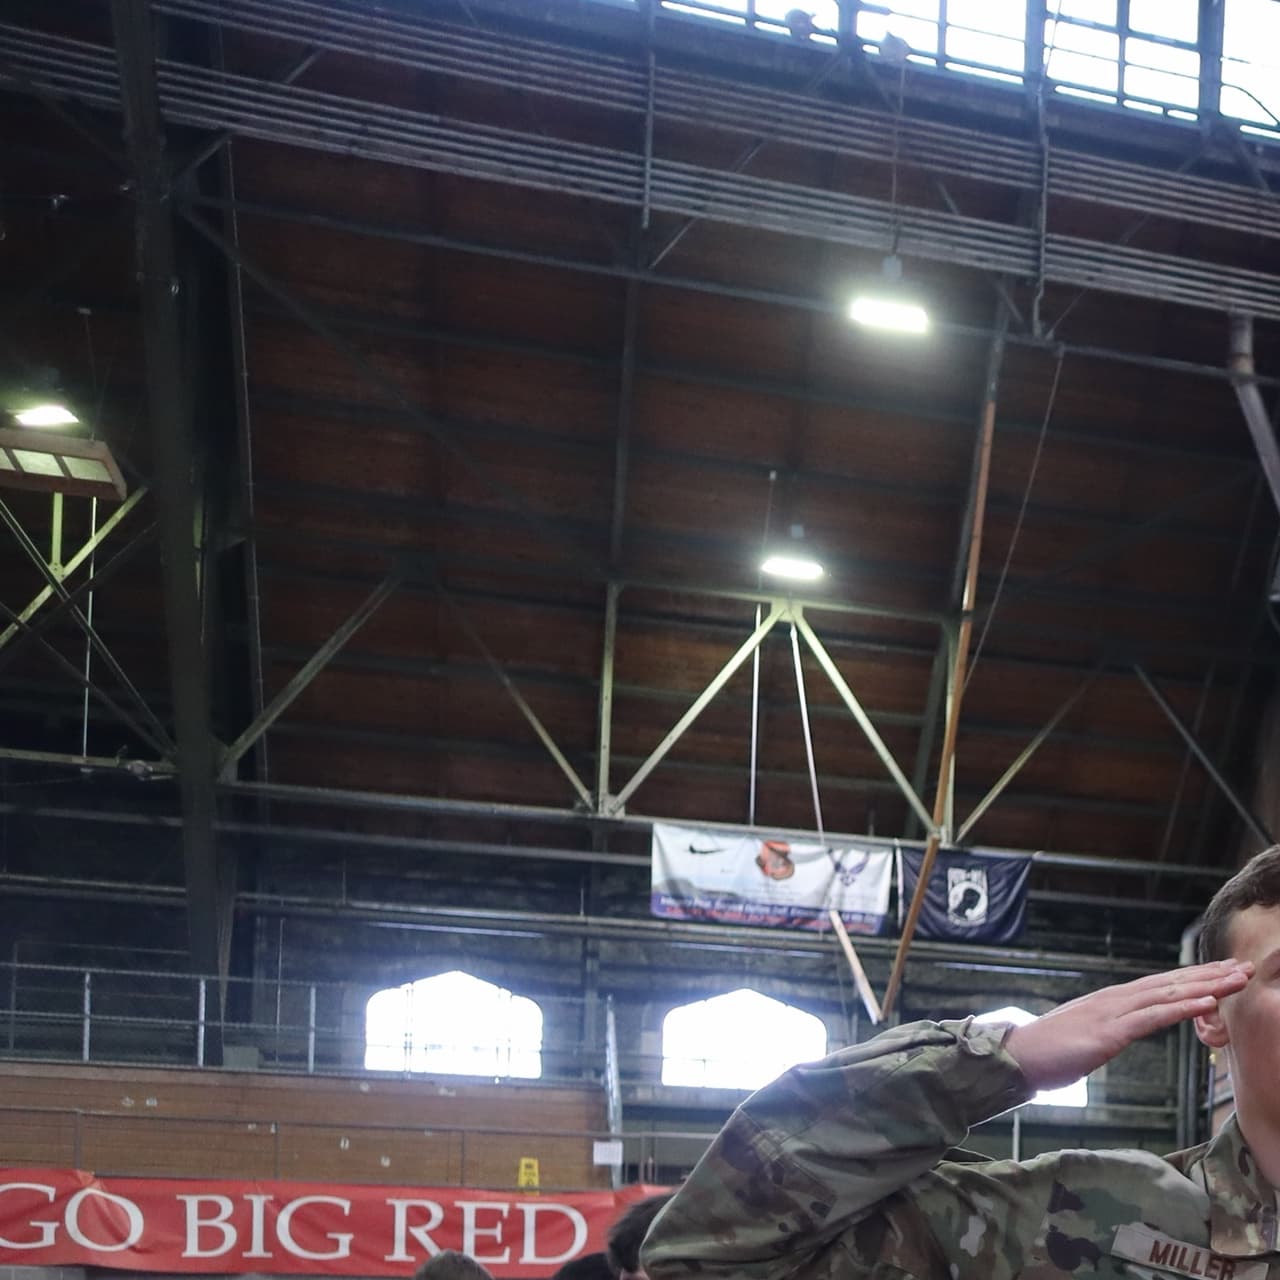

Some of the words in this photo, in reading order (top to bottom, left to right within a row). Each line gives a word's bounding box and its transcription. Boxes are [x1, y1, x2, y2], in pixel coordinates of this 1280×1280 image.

[0, 1183, 144, 1252] GO
[176, 1194, 354, 1260] BIG
[385, 1197, 587, 1265] RED
